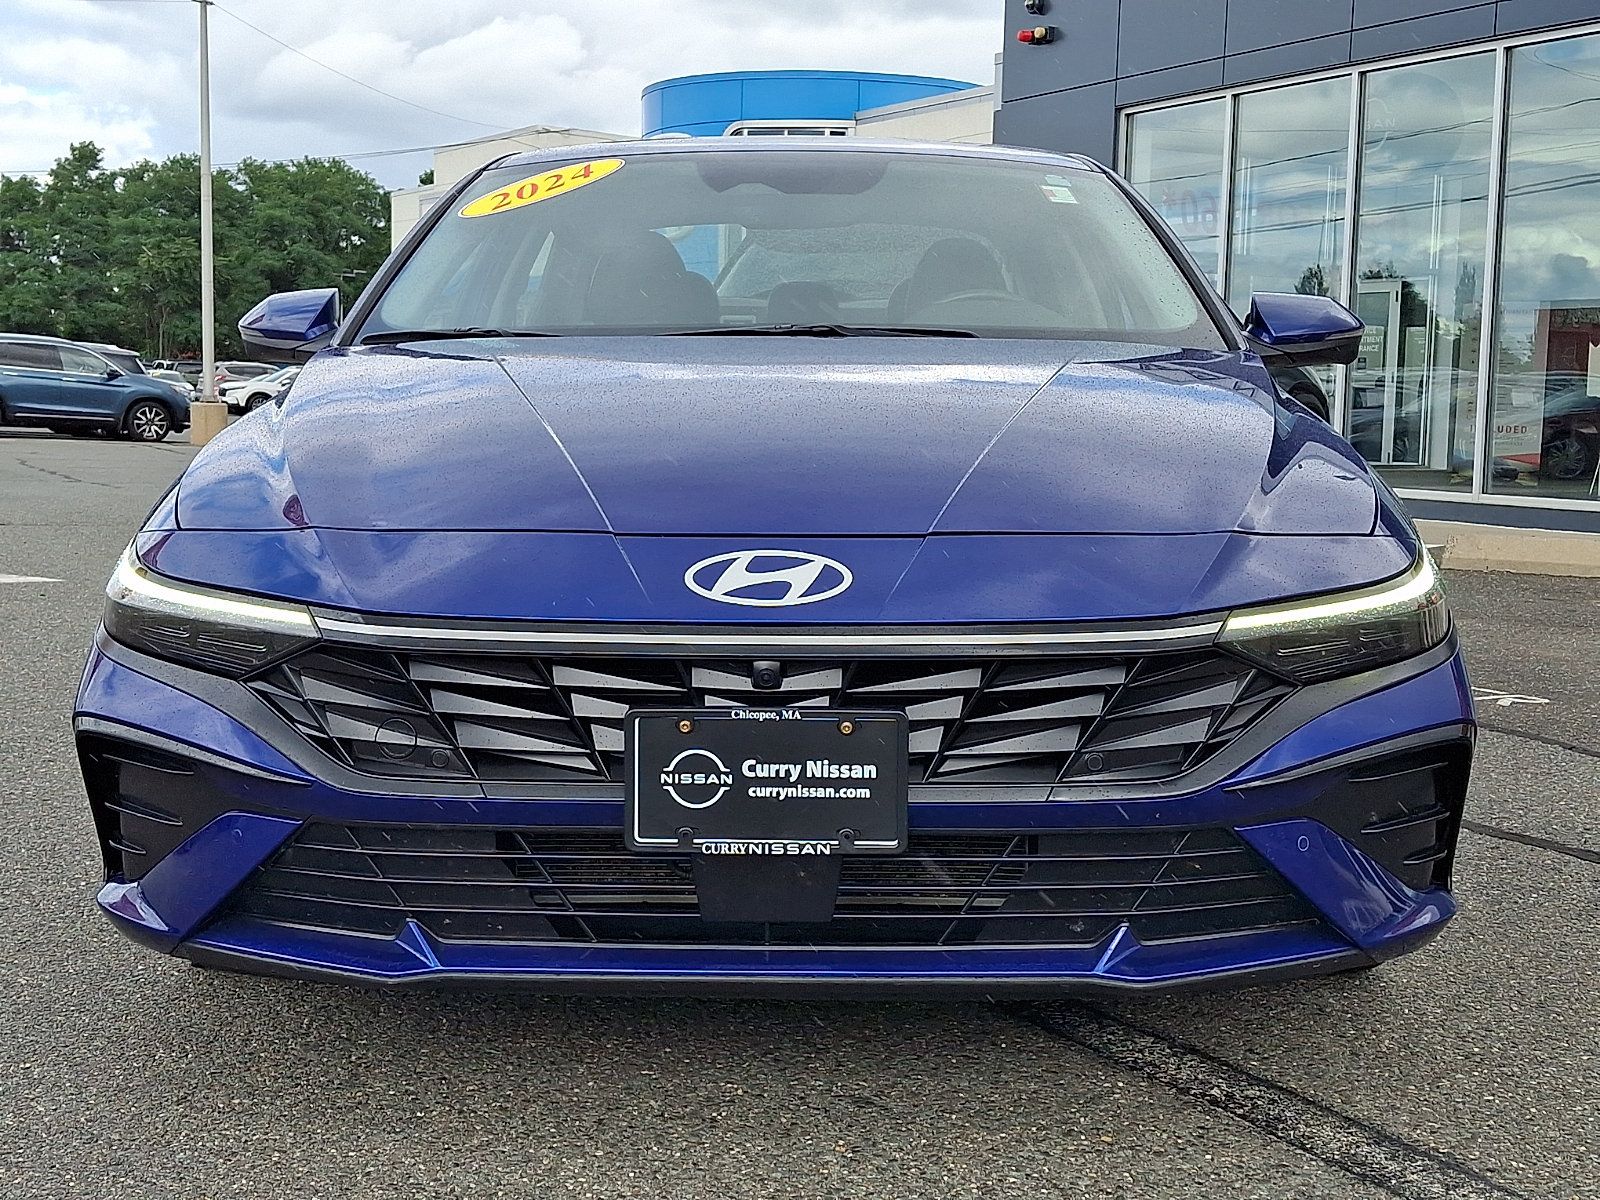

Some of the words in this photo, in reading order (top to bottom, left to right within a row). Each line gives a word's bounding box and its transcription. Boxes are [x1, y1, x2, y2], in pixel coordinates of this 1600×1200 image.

[491, 163, 594, 211] 2024
[731, 709, 780, 721] Chicopee,
[781, 710, 801, 720] MA
[741, 759, 802, 782] Curry
[806, 759, 877, 779] Nissan
[660, 773, 733, 785] NISSAN
[748, 784, 871, 800] currynissan.com
